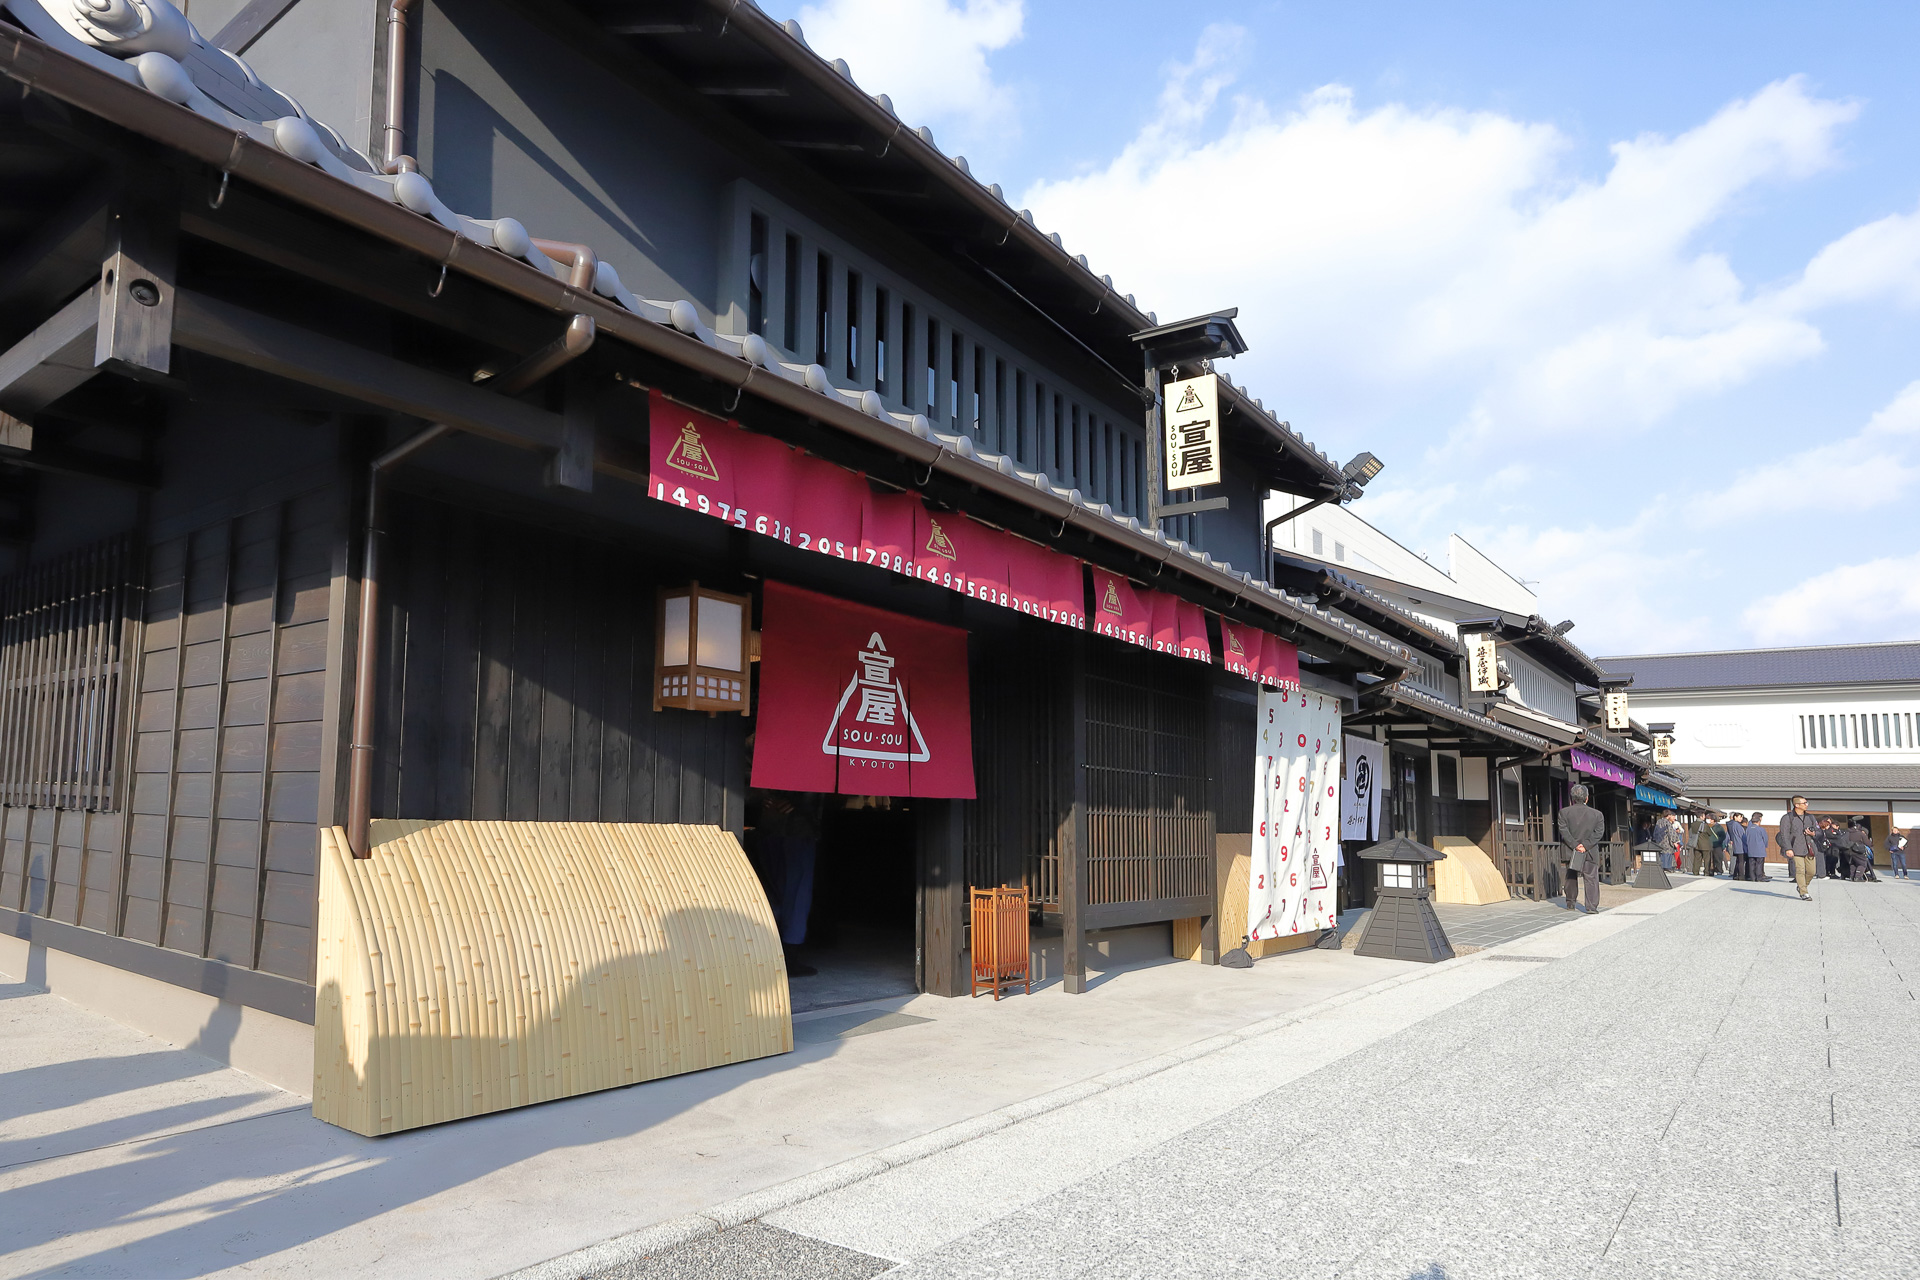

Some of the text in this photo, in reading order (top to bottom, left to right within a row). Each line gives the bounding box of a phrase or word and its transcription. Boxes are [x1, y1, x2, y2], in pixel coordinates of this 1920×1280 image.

[681, 427, 703, 463] 宣屋
[1178, 419, 1214, 477] 宣屋
[855, 650, 897, 726] 宣屋
[849, 758, 896, 770] KYOTO
